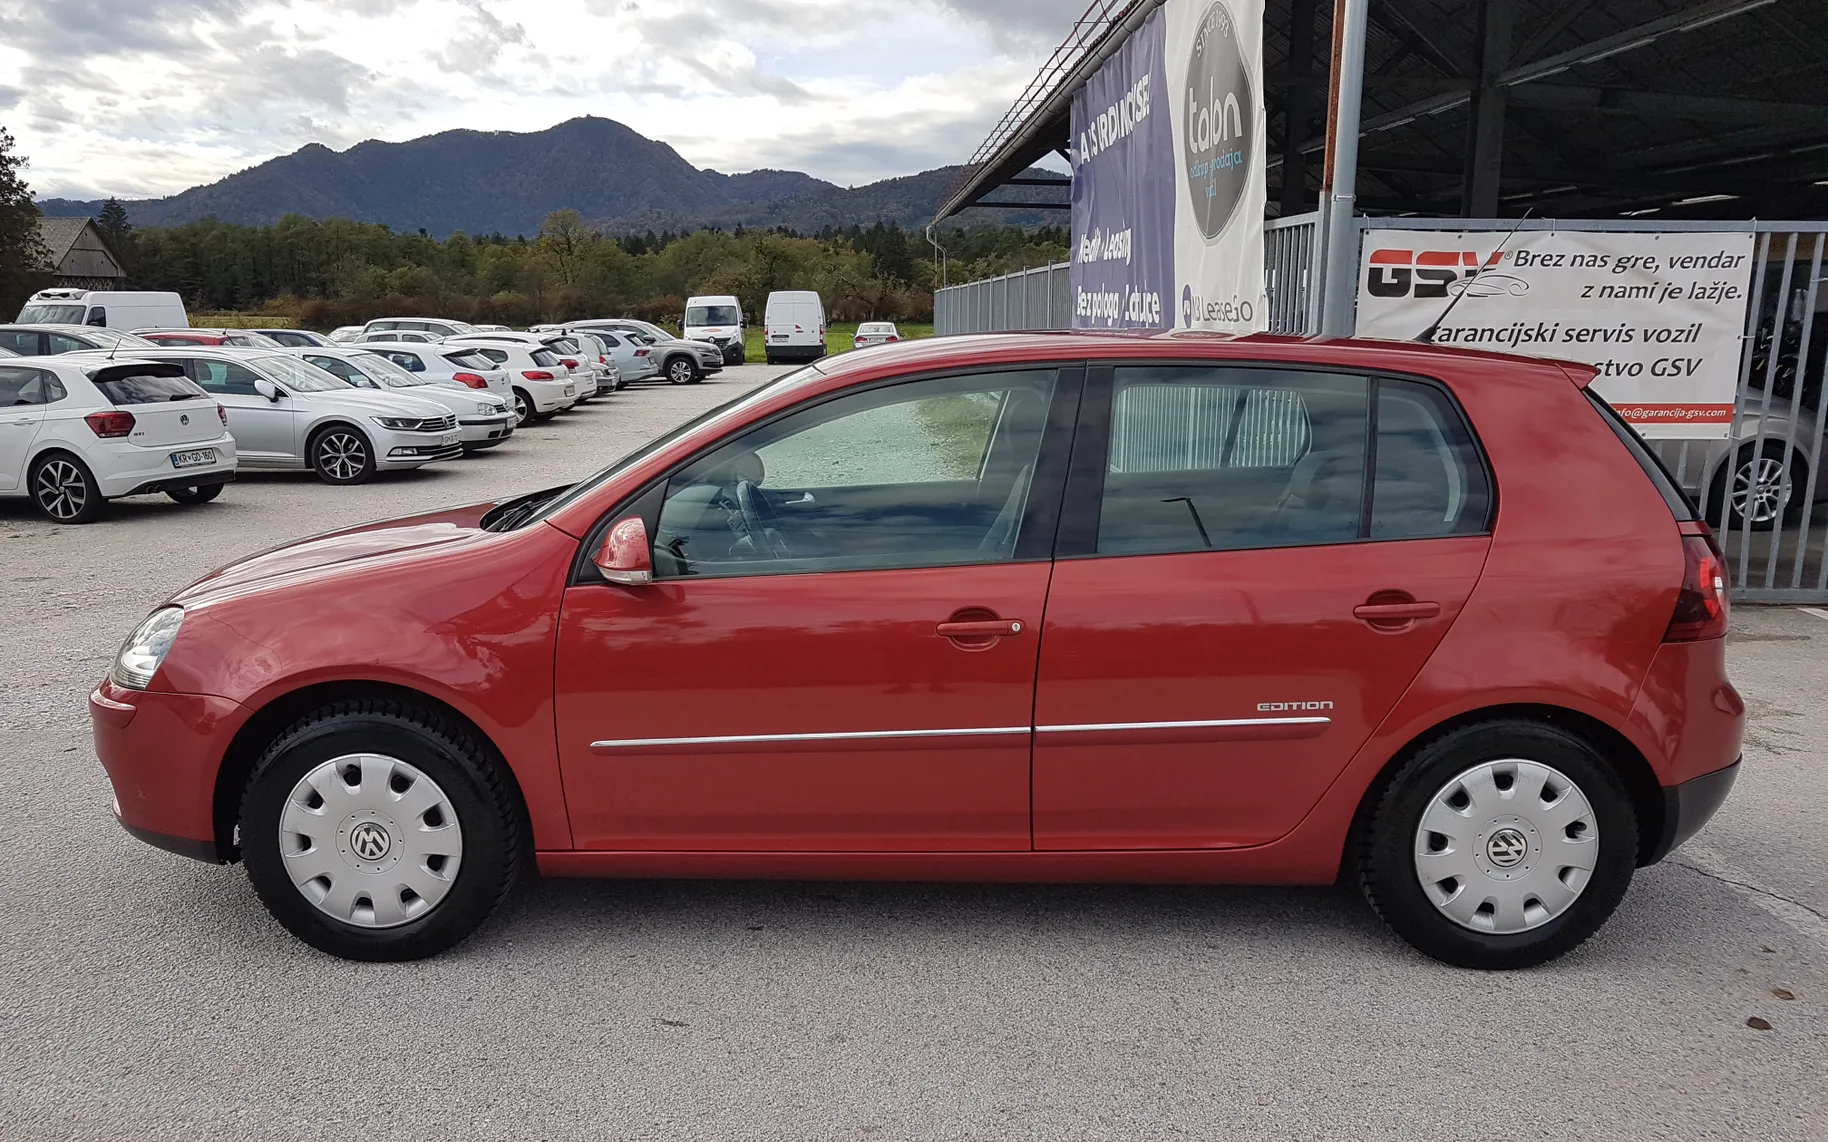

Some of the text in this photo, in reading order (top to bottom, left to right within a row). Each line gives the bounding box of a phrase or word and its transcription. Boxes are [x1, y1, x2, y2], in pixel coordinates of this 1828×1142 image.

[1514, 249, 1746, 274] Brez nas gre, vendar
[1367, 249, 1505, 298] GSV
[1581, 280, 1743, 305] z nami je lažje.
[1561, 322, 1636, 344] servis
[1643, 322, 1703, 344] vozil
[1650, 358, 1704, 378] GSV
[1613, 407, 1727, 421] nfo@garancija-gsv.com
[177, 453, 189, 464] KR
[1256, 700, 1334, 712] EDITION
